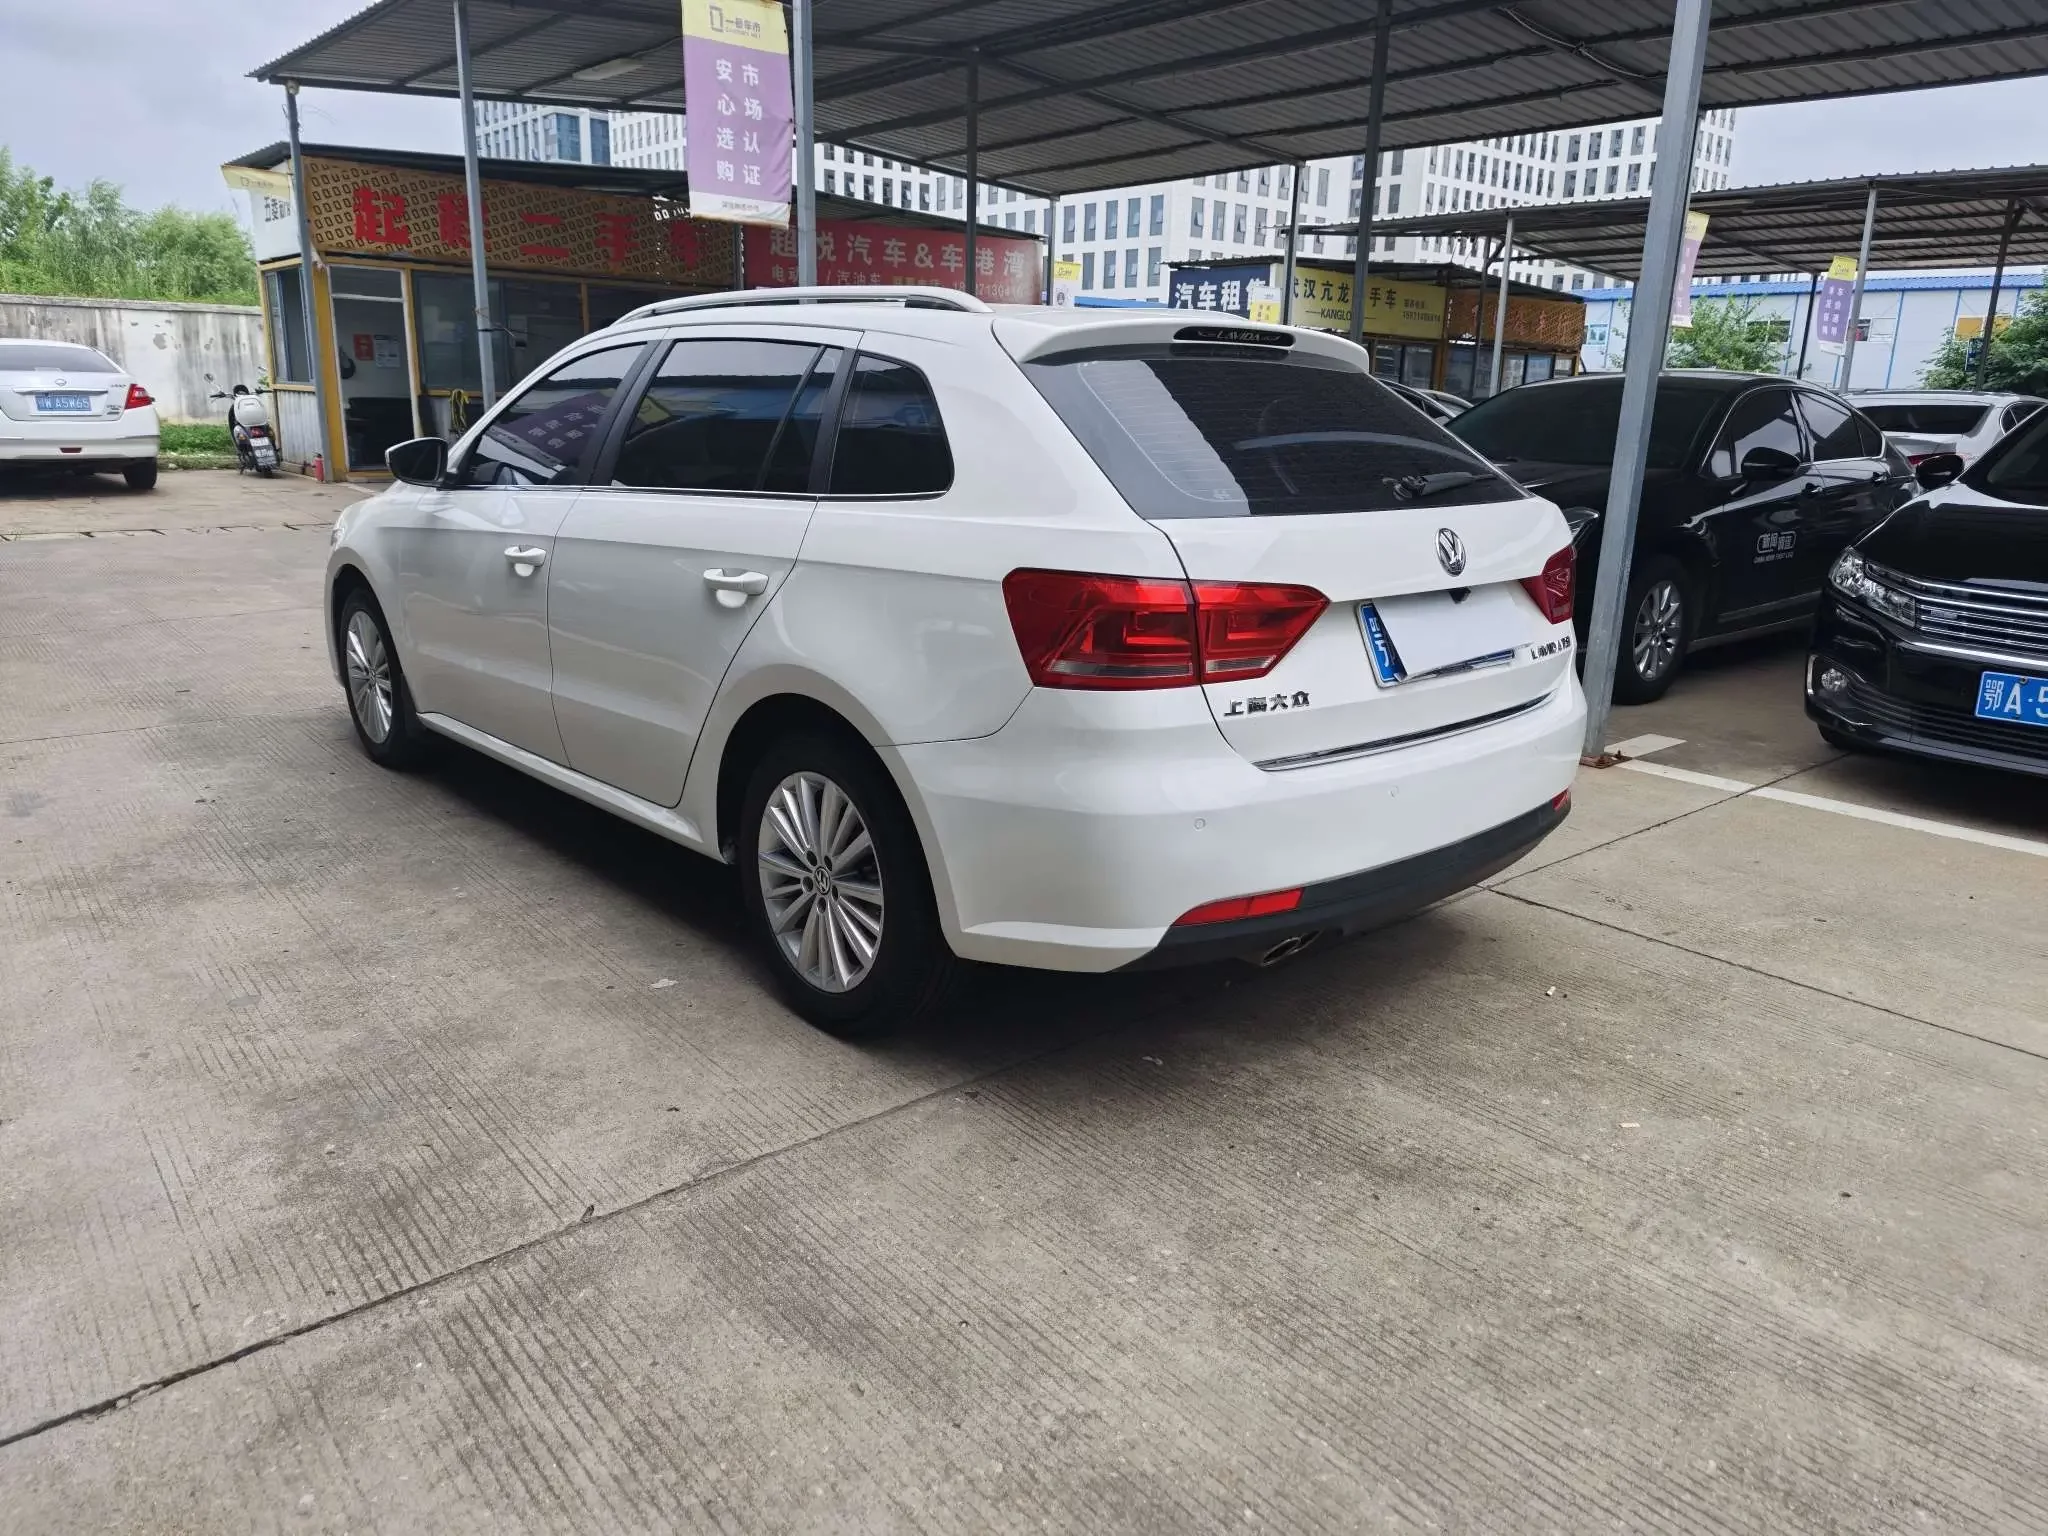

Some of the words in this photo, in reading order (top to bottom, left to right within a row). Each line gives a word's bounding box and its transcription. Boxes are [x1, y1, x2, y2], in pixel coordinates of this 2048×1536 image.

[716, 58, 737, 183] 安心选购
[741, 63, 763, 186] 市场认证
[1292, 276, 1397, 310] 汉亢龙手车
[1320, 307, 1353, 321] KANGLO
